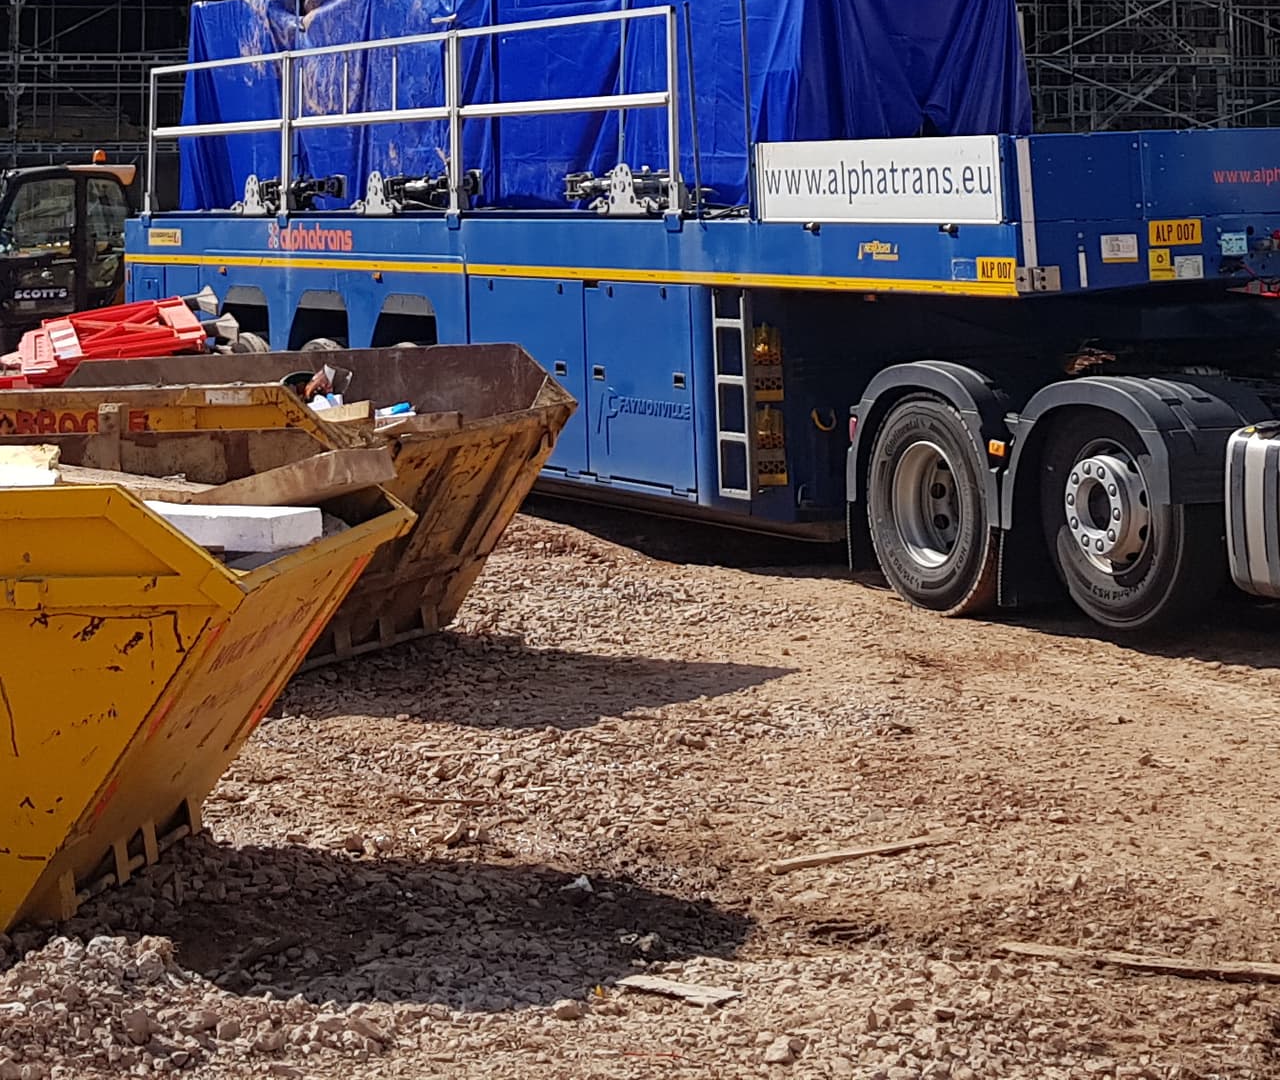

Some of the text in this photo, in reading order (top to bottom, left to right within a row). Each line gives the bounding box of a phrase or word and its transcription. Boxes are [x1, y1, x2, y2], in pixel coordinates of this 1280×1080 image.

[765, 160, 993, 205] www.alphatrans.eu
[280, 222, 353, 251] alphatrans
[1156, 223, 1196, 242] ALP 007
[981, 261, 1013, 279] ALP 007
[14, 288, 68, 299] SCOTT'S
[619, 396, 691, 421] FAYMONVILLE
